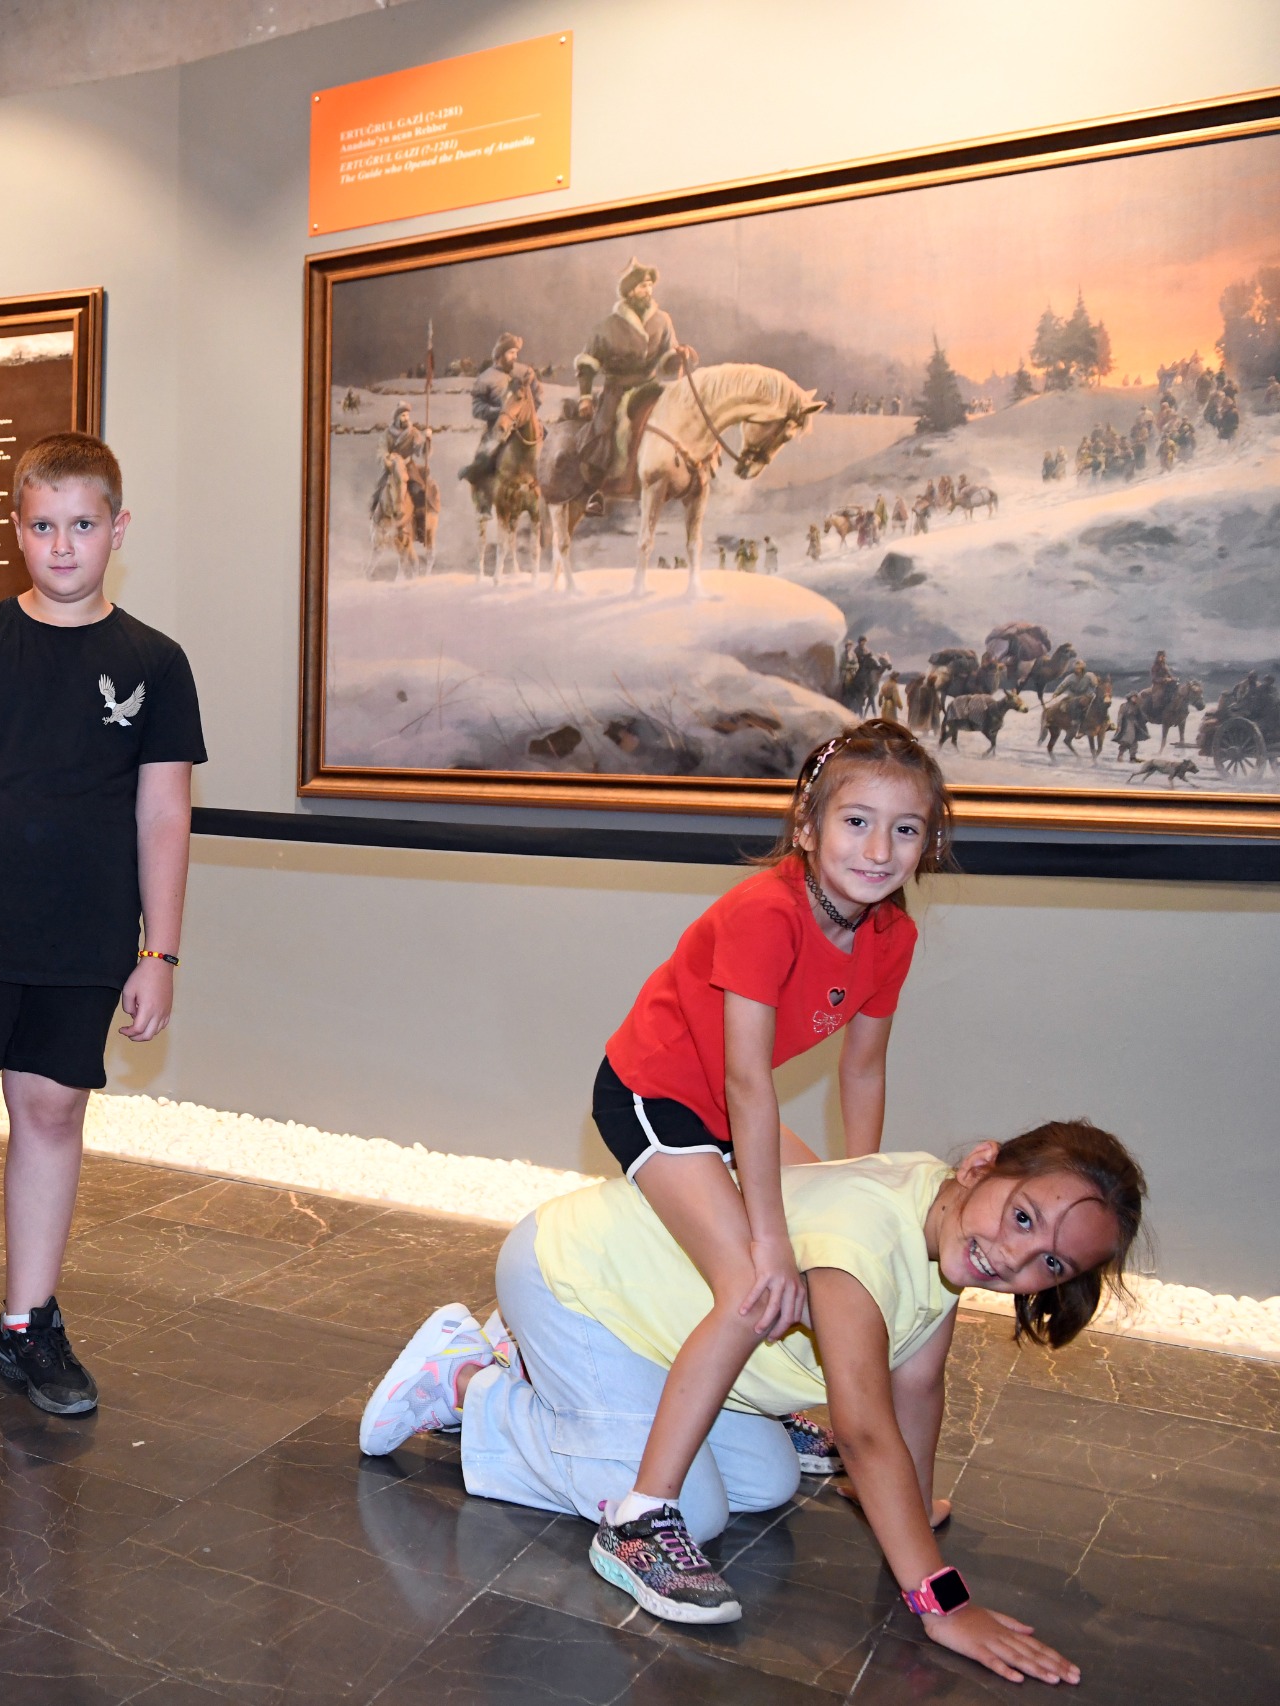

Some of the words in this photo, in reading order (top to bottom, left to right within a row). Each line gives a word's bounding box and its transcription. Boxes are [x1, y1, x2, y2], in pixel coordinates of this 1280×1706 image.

[340, 121, 394, 140] ERTUĞRUL
[415, 123, 448, 135] Rehber
[340, 174, 355, 184] The
[358, 168, 382, 180] Guide
[384, 164, 402, 175] who
[404, 156, 437, 171] Opened
[438, 153, 454, 163] the
[455, 147, 482, 159] Doors
[483, 143, 494, 155] of
[497, 135, 535, 151] Anatolia
